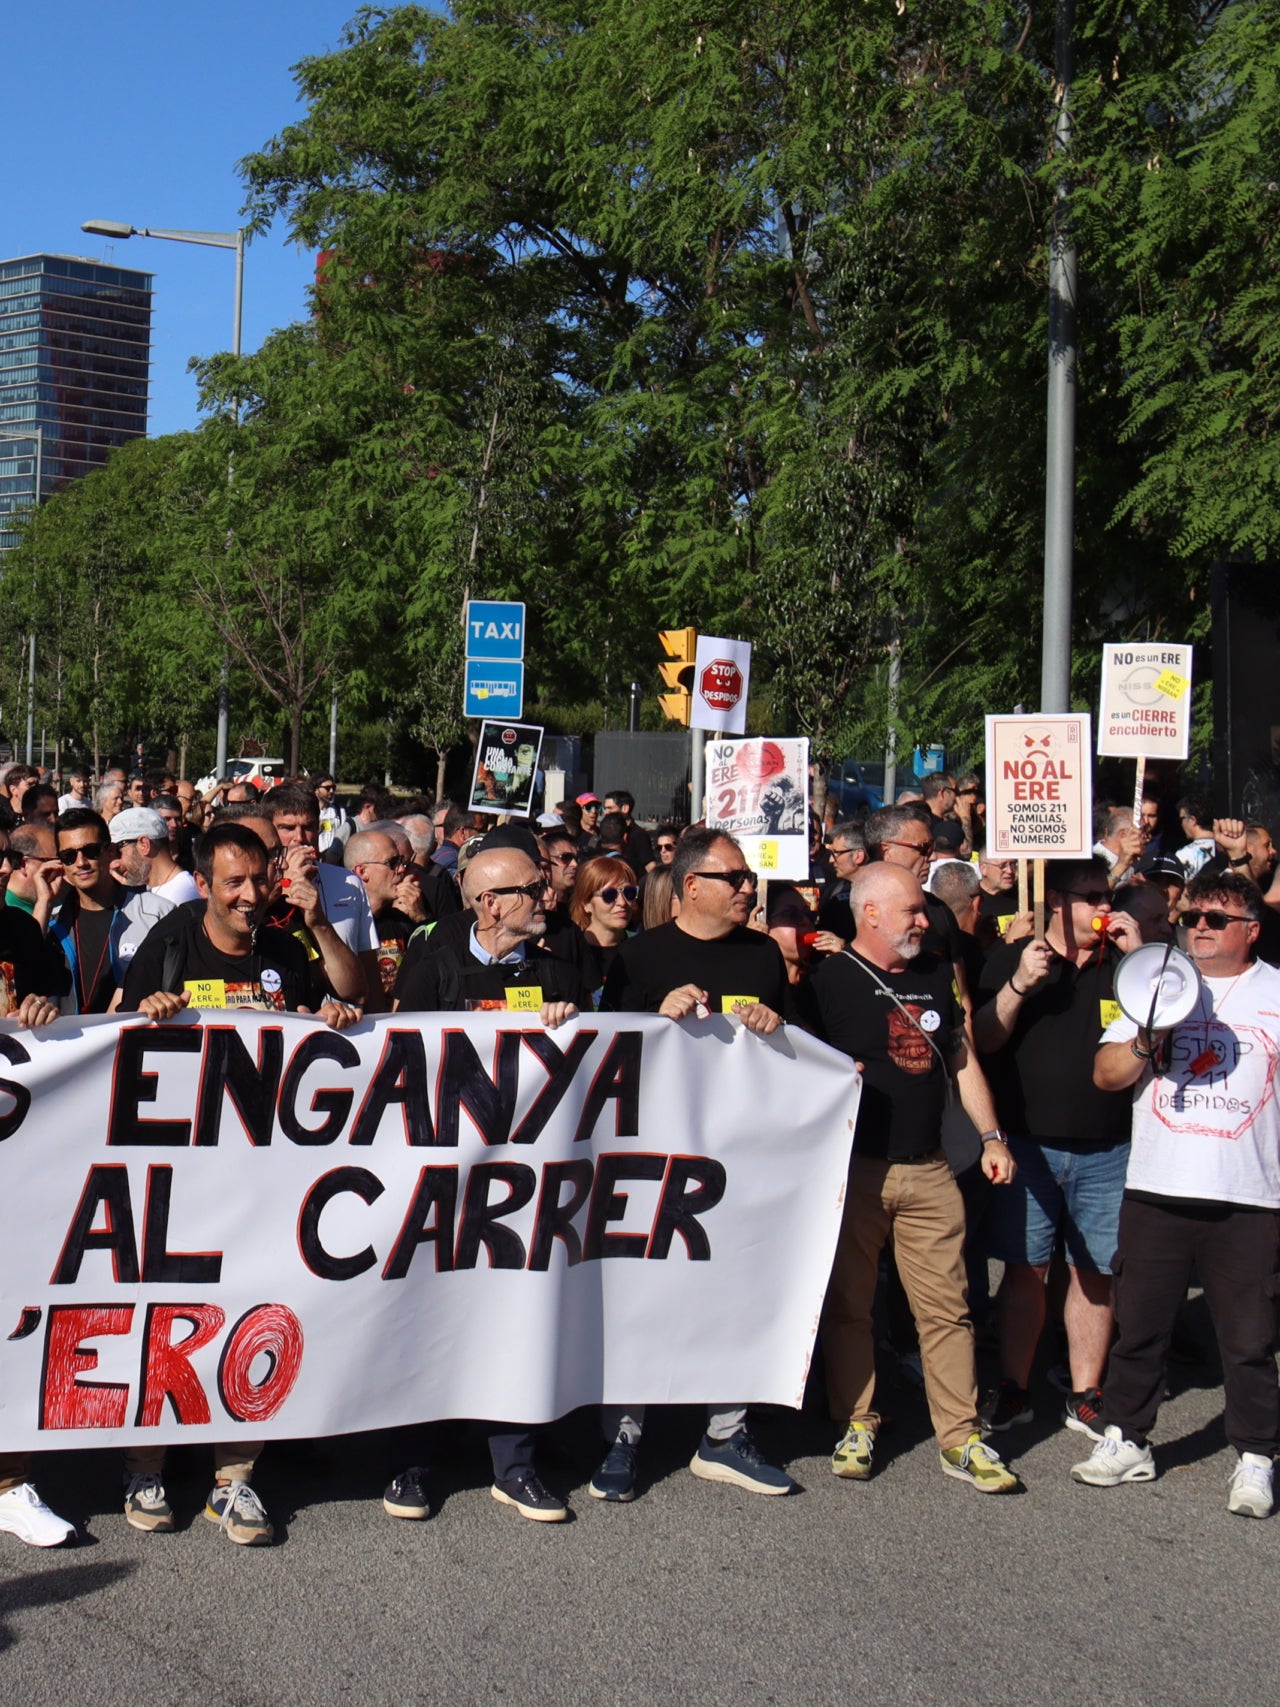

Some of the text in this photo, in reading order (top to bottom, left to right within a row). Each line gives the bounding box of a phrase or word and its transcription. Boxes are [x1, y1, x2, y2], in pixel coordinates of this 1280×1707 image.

[471, 621, 520, 640] TAXI
[1113, 652, 1181, 666] NO es un ERE
[710, 664, 737, 678] STOP
[704, 690, 739, 703] DESPIDOS
[1121, 711, 1131, 719] un
[1132, 708, 1176, 724] CIERRE
[1109, 723, 1177, 738] encubierto
[713, 744, 735, 761] NO
[712, 763, 740, 784] ERE
[1003, 760, 1073, 780] NO AL
[1014, 781, 1061, 800] ERE
[717, 782, 763, 820] 211
[1007, 803, 1067, 813] SOMOS 211
[1010, 824, 1067, 834] NO SOMOS
[1012, 833, 1066, 844] NÚMEROS
[197, 983, 212, 992] NO
[517, 990, 531, 998] NO
[197, 995, 213, 1003] ERE
[236, 995, 252, 1004] PARA
[735, 998, 748, 1007] NO
[106, 1024, 643, 1147] ENGANYA
[1180, 1069, 1229, 1092] 211
[1158, 1093, 1252, 1115] DESPIDOS
[49, 1163, 223, 1285] AL
[296, 1153, 727, 1281] CARRER
